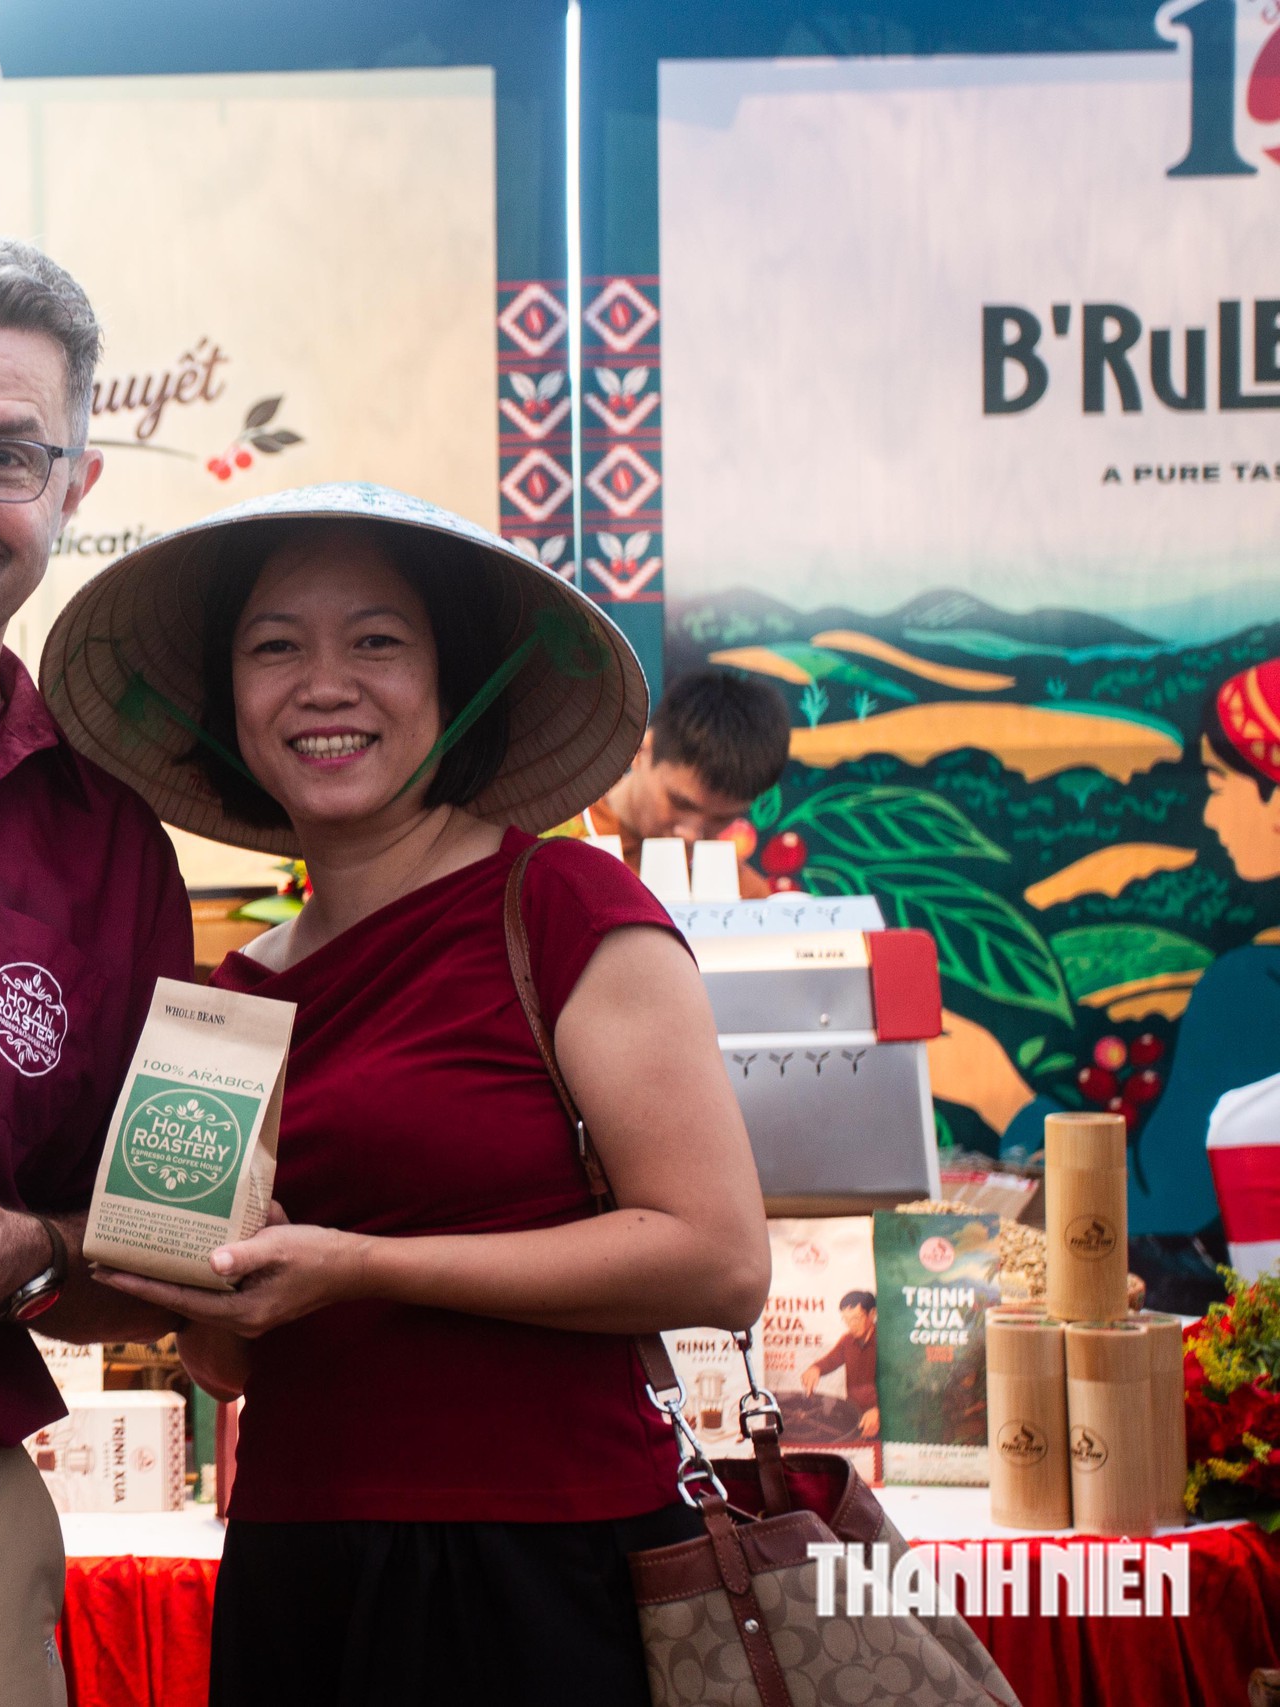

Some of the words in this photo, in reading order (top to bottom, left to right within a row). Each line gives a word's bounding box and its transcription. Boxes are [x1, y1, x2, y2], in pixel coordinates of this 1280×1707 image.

[1102, 463, 1122, 485] A
[1133, 462, 1220, 485] PURE
[6, 987, 32, 1015] HOI
[32, 1004, 54, 1028] AN
[165, 1004, 195, 1020] WHOLE
[197, 1011, 226, 1025] BEANS
[143, 1059, 184, 1077] 100%
[188, 1069, 265, 1093] ARABICA
[132, 1127, 231, 1162] ROASTERY
[152, 1116, 186, 1138] HOI
[187, 1124, 217, 1145] AN
[131, 1147, 165, 1161] ESPRESSO
[172, 1155, 199, 1168] COFFEE
[200, 1161, 224, 1173] HOUSE
[99, 1214, 113, 1223] 135
[114, 1216, 137, 1229] TRAN
[138, 1221, 157, 1233] PHU
[158, 1226, 191, 1240] STREET
[195, 1234, 211, 1245] HOI
[212, 1239, 226, 1247] AN
[100, 1201, 135, 1214] COFFEE
[135, 1207, 172, 1221] ROASTED
[173, 1214, 191, 1226] FOR
[192, 1219, 229, 1234] FRIENDS
[95, 1231, 211, 1263] WWW.HOIANROASTERY.CO
[96, 1223, 152, 1241] TELEPHONE
[157, 1236, 181, 1248] 0235
[763, 1334, 823, 1347] COFFEE
[909, 1330, 969, 1345] COFFEE
